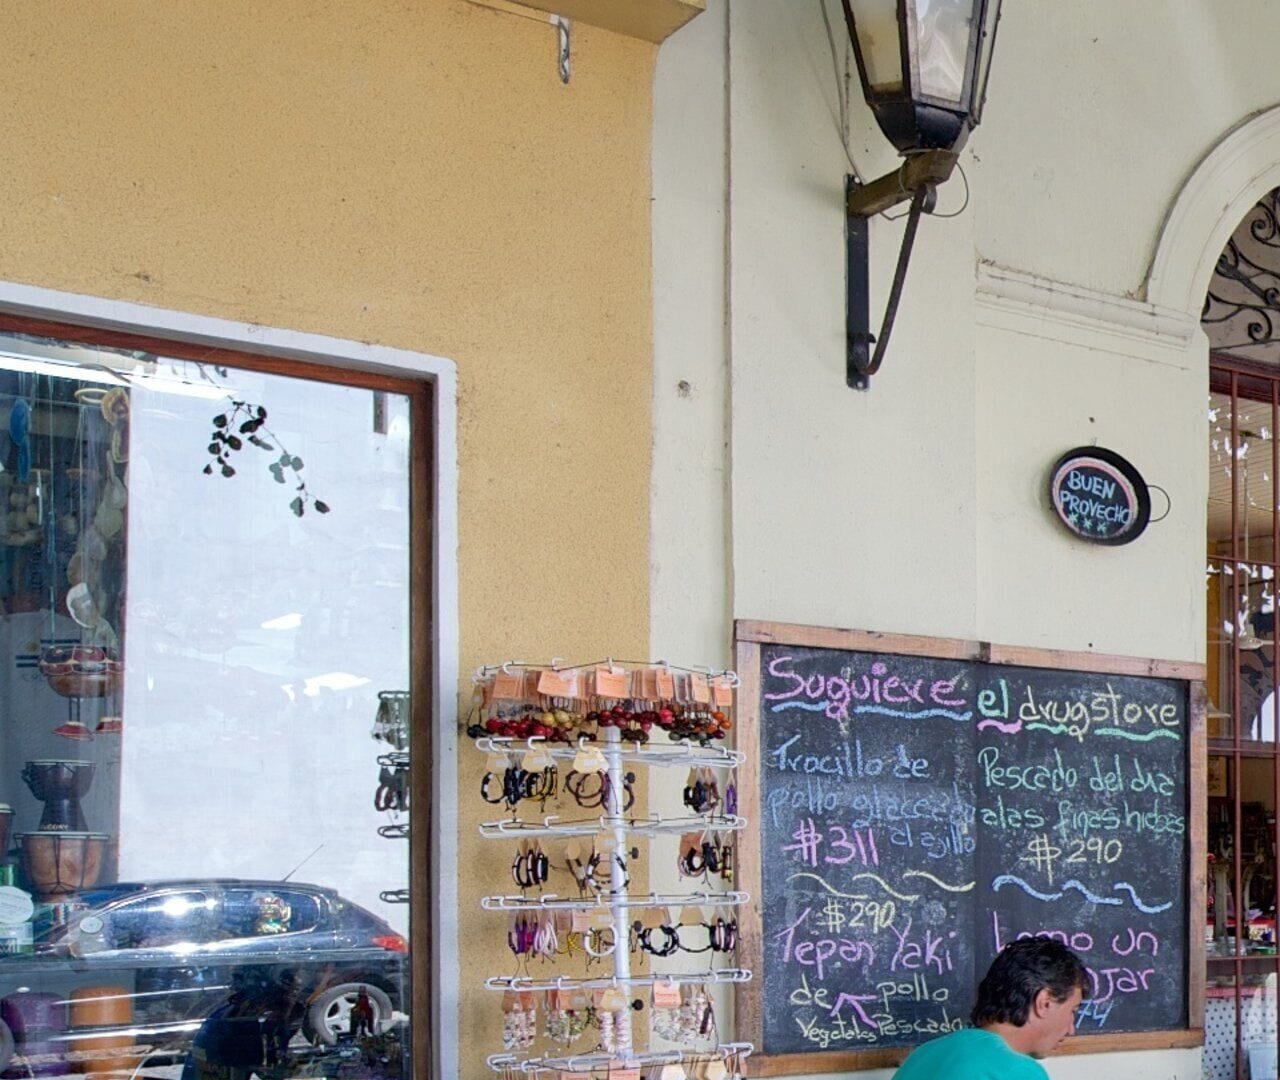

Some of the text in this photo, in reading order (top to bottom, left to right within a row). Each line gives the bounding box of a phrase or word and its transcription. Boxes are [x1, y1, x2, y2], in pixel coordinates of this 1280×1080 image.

[1067, 470, 1116, 499] BUEN
[1060, 490, 1132, 524] PROVECHO
[977, 678, 1180, 743] el drugstore
[892, 743, 931, 779] de
[977, 746, 1078, 793] Pescado
[1089, 753, 1124, 793] del
[767, 777, 838, 828] pollo
[781, 816, 880, 869] $311
[1018, 832, 1123, 886] $290
[822, 897, 897, 934] $290
[773, 907, 876, 981] Tepan
[1112, 927, 1159, 957] un
[789, 972, 950, 1013] de pollo
